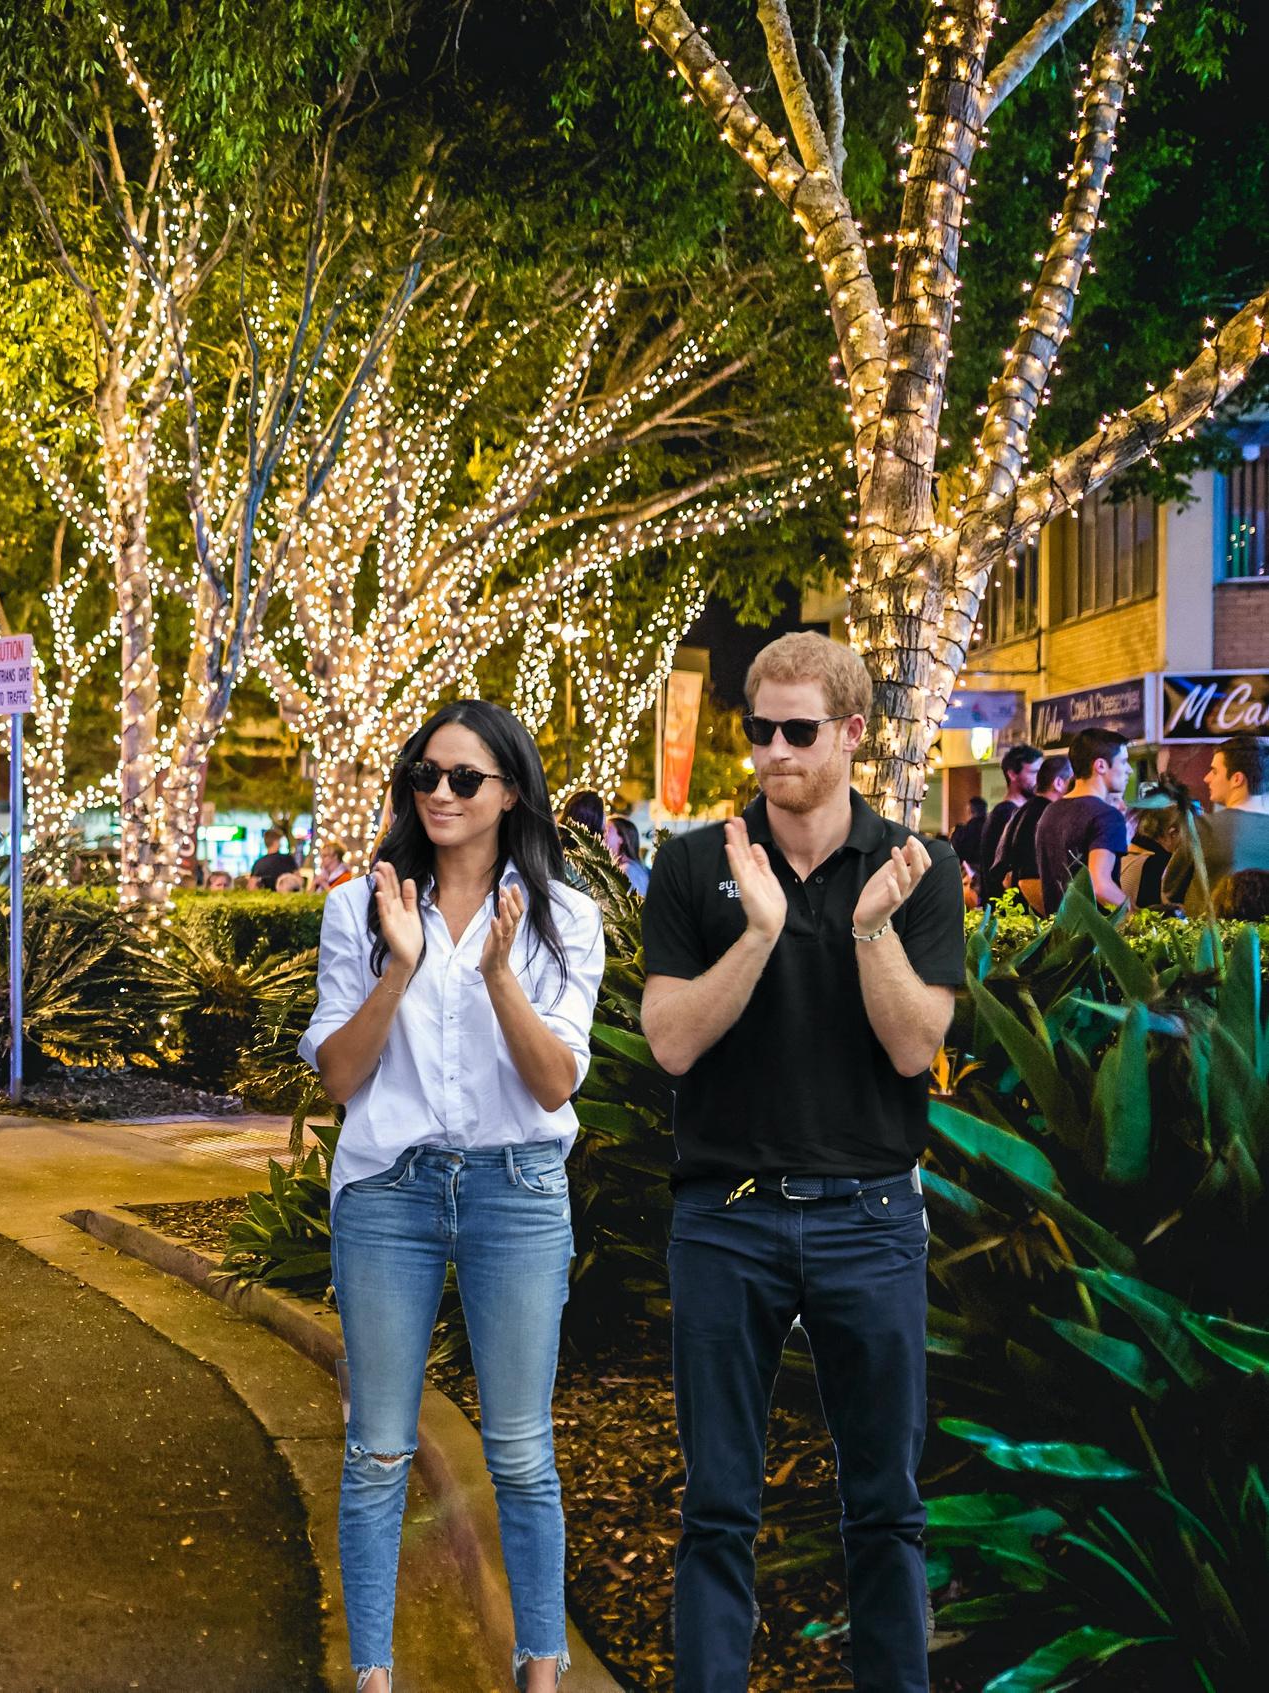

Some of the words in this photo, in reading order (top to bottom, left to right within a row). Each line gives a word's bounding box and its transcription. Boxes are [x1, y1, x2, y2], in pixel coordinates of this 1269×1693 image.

[18, 667, 30, 681] GIVE
[7, 690, 27, 705] TRAFFIC
[1170, 682, 1218, 731] M
[1218, 683, 1269, 729] Ca
